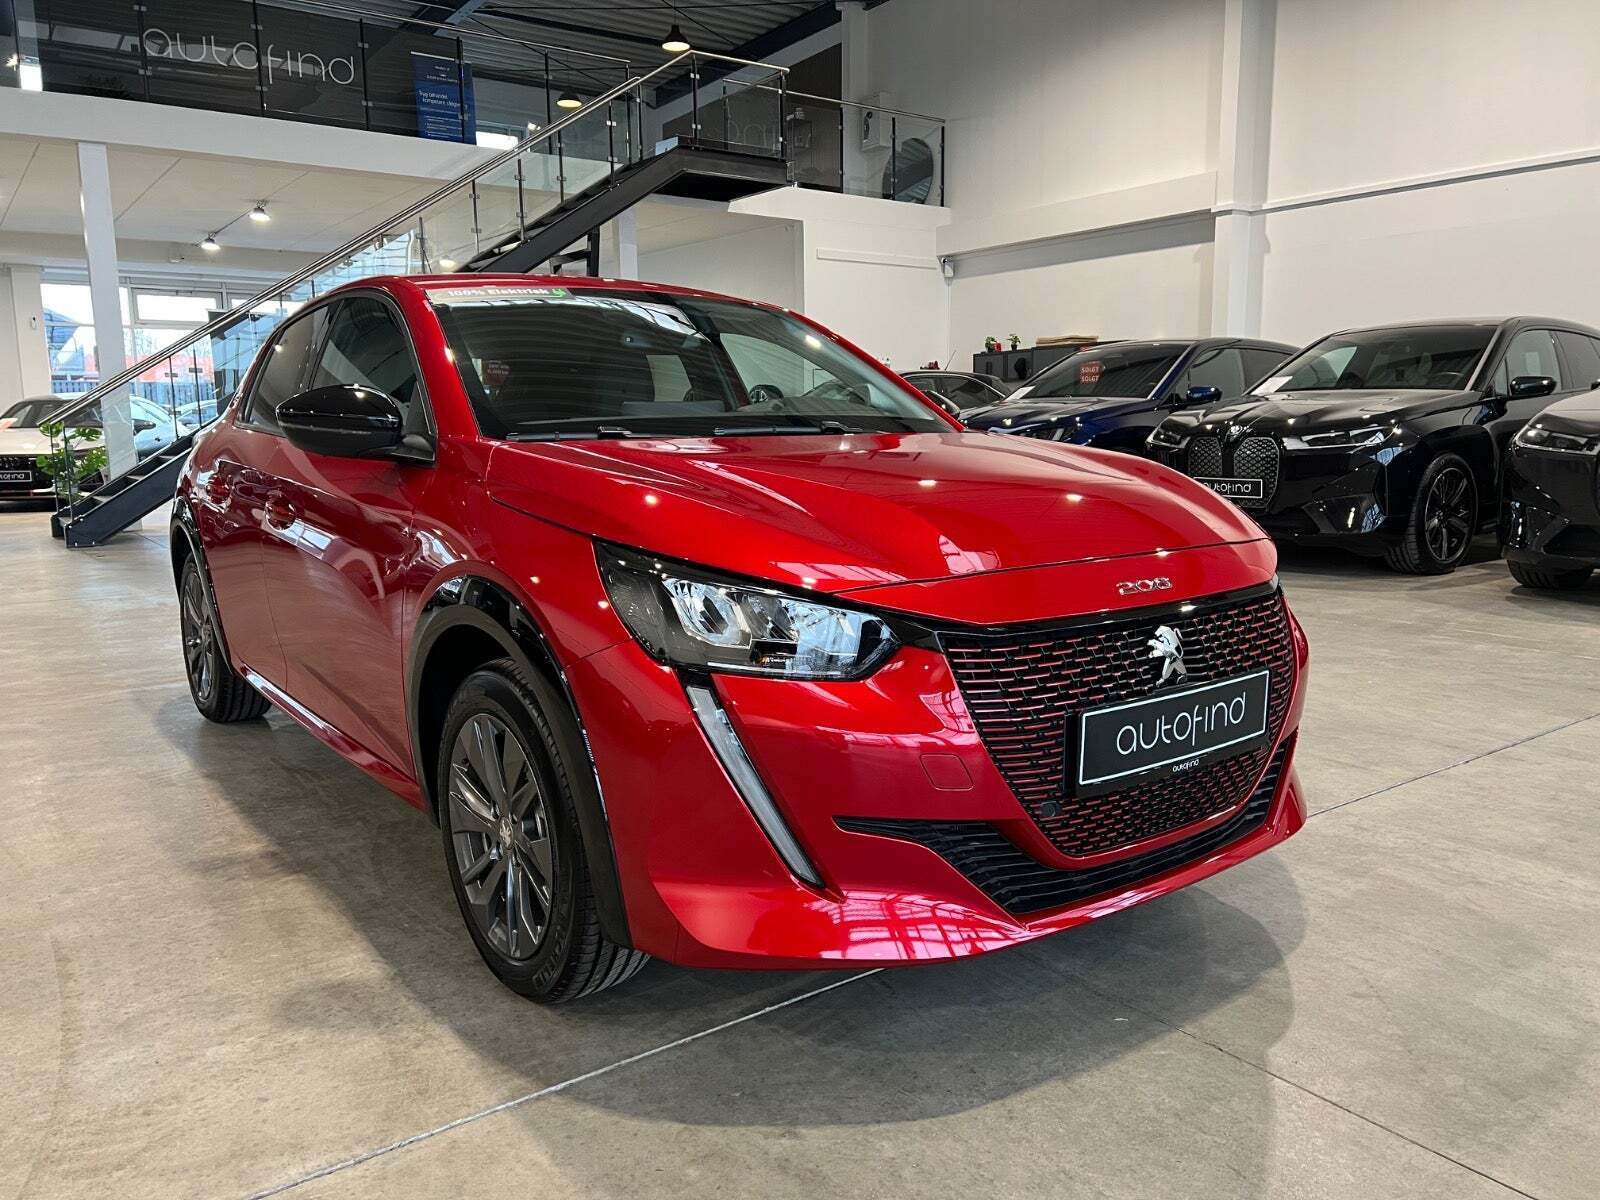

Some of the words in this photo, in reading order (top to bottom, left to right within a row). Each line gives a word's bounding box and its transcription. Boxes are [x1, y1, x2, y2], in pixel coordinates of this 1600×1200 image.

[143, 28, 354, 84] autofind
[448, 289, 482, 298] 100%
[1115, 577, 1173, 595] 208
[1116, 691, 1246, 755] autofind
